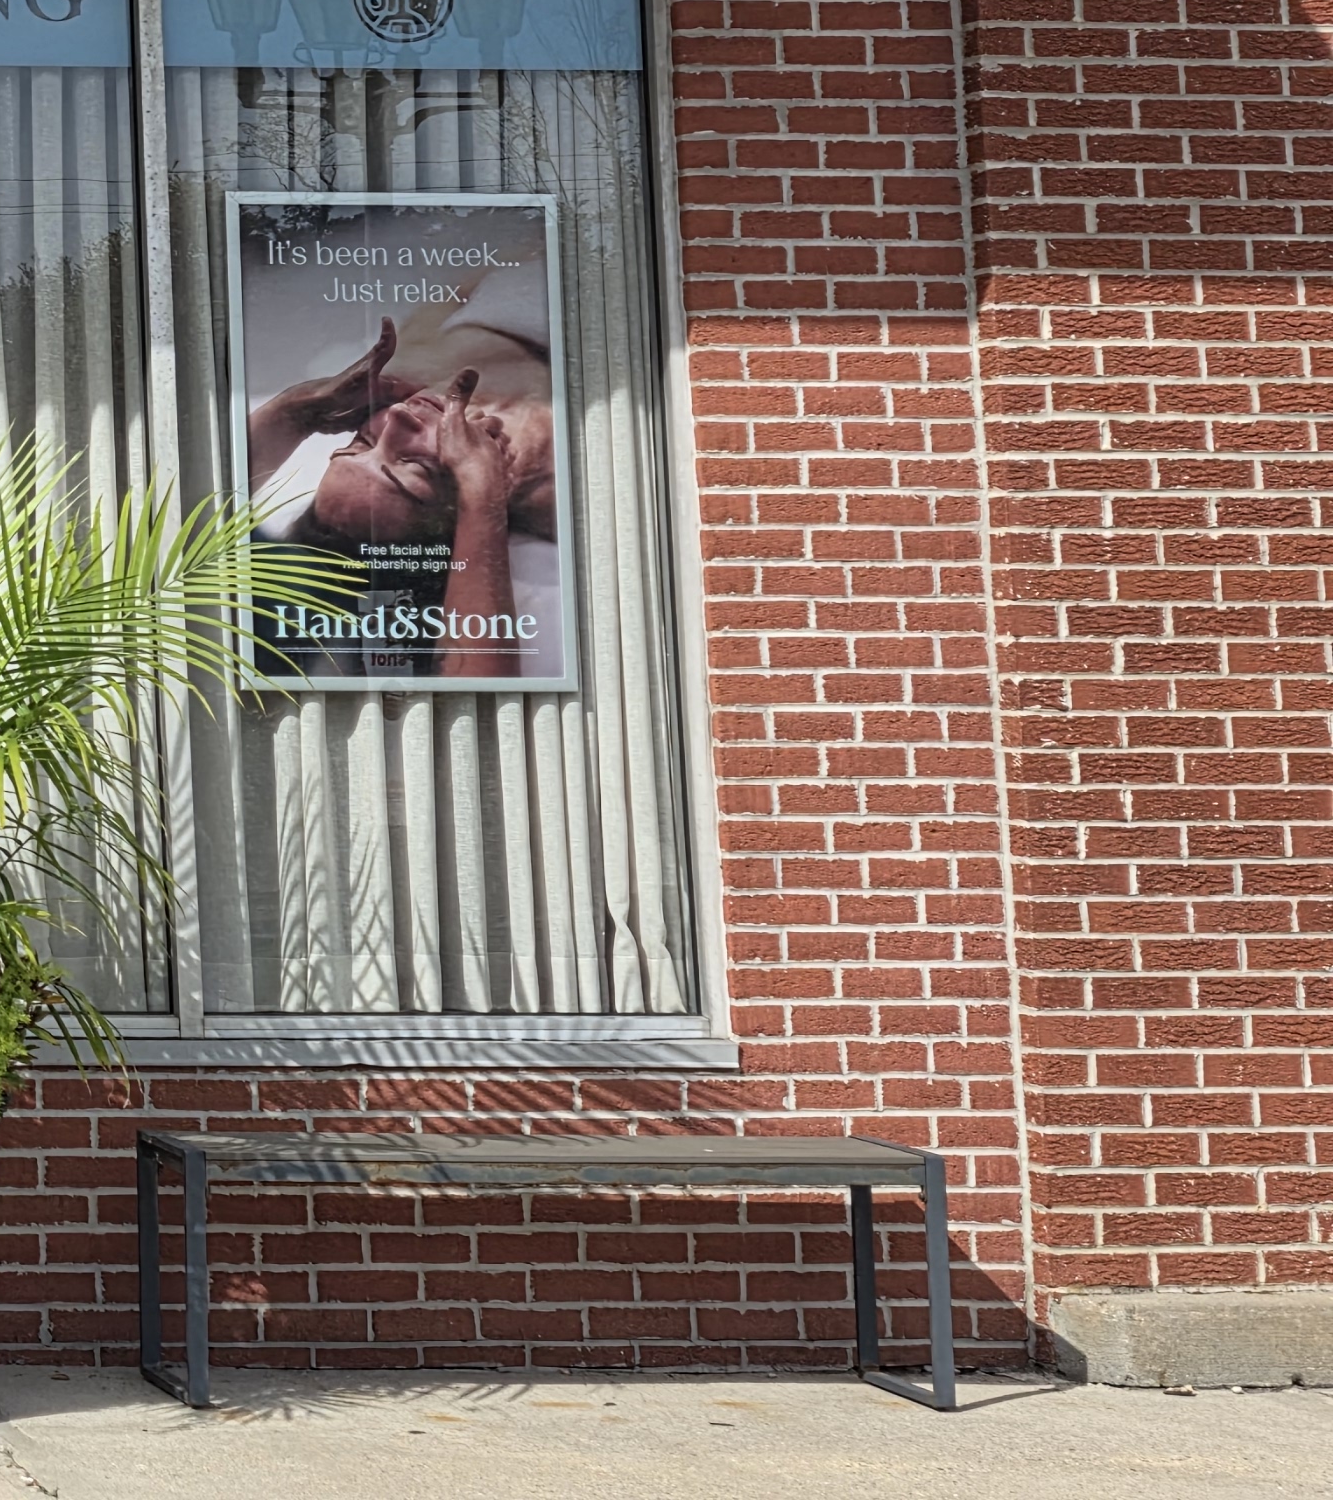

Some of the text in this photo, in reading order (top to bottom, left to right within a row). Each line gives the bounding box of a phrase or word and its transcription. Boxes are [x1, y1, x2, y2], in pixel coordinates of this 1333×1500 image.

[268, 240, 520, 267] It's been a week...
[323, 277, 469, 304] Just relax.
[360, 543, 451, 556] Free facial with
[422, 558, 448, 573] sign
